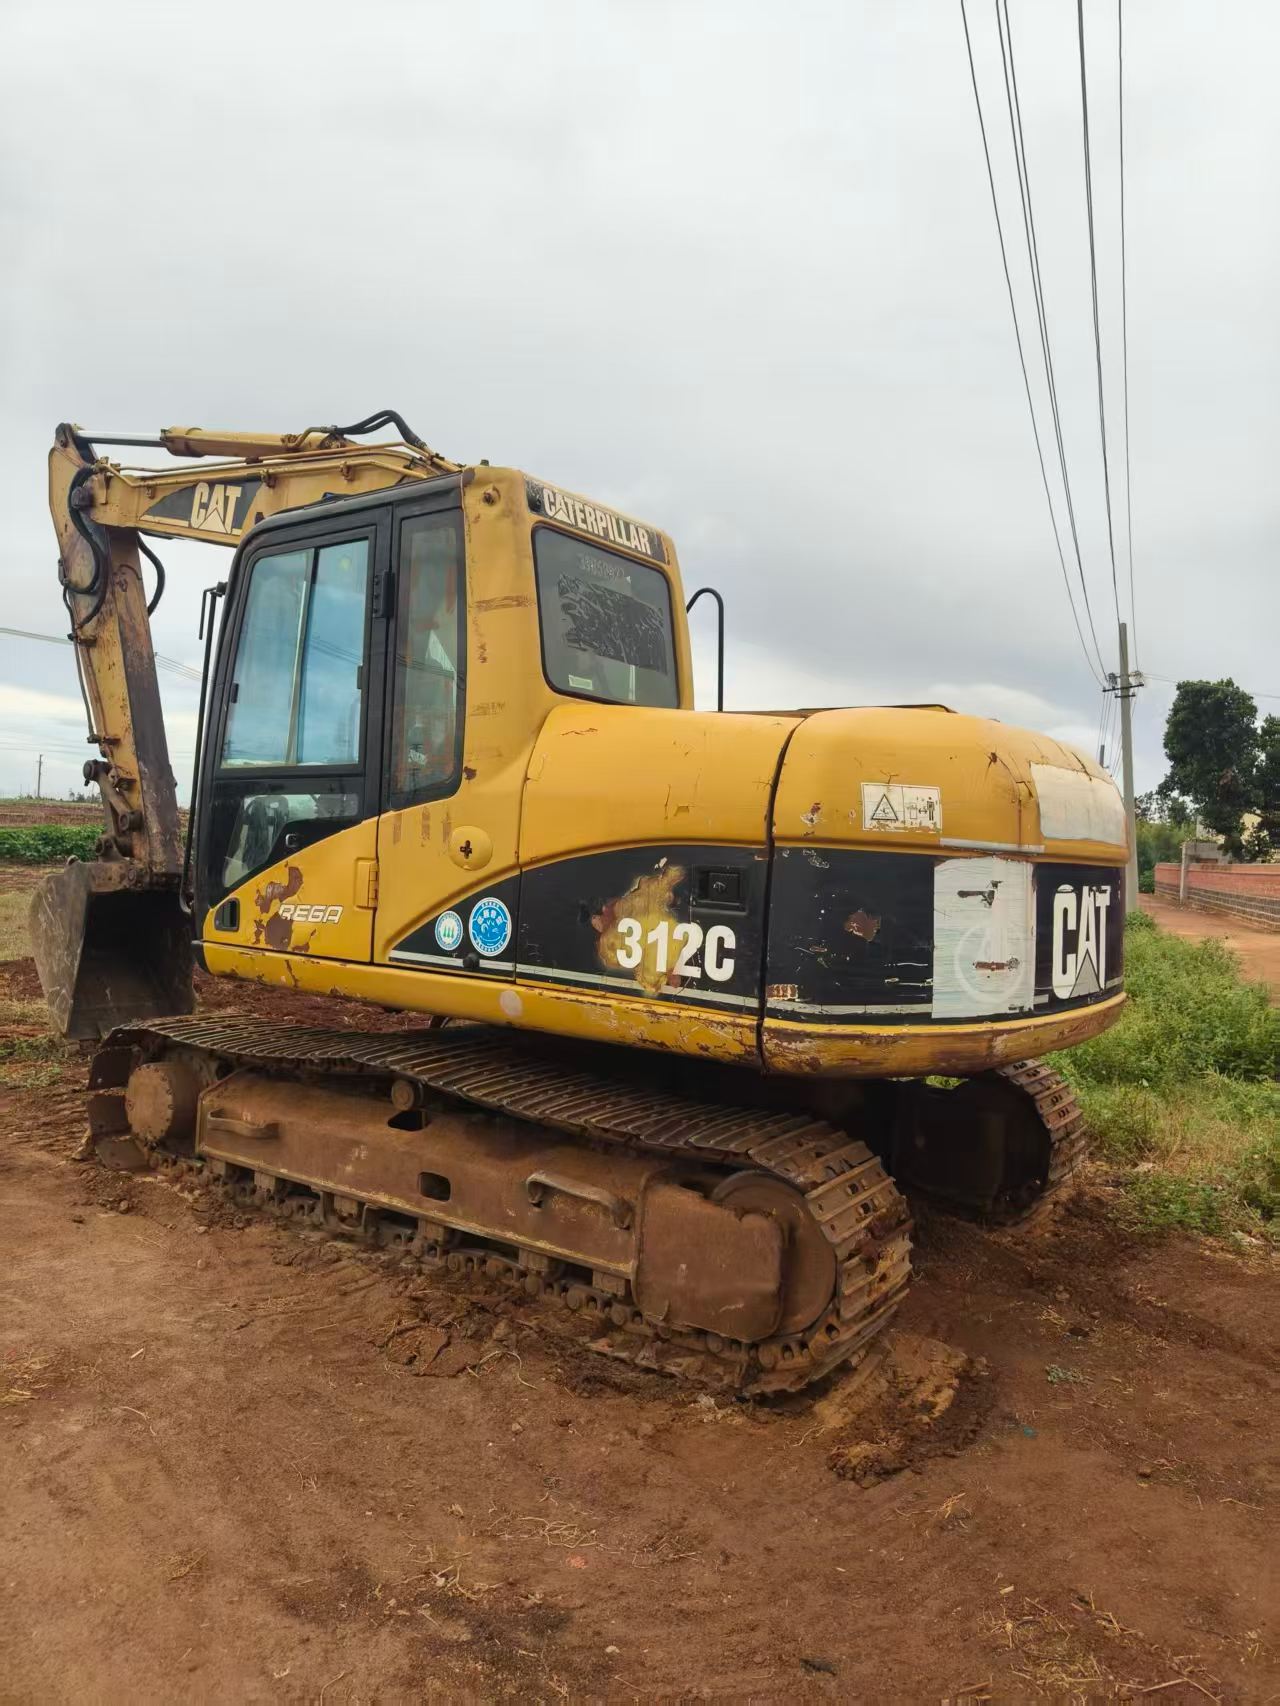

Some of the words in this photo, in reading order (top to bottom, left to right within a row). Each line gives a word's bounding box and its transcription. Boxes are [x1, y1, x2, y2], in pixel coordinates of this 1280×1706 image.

[190, 482, 242, 535] CAT
[543, 488, 652, 555] CATERPILLAR
[616, 917, 736, 982] 312C
[1052, 884, 1111, 999] CAT
